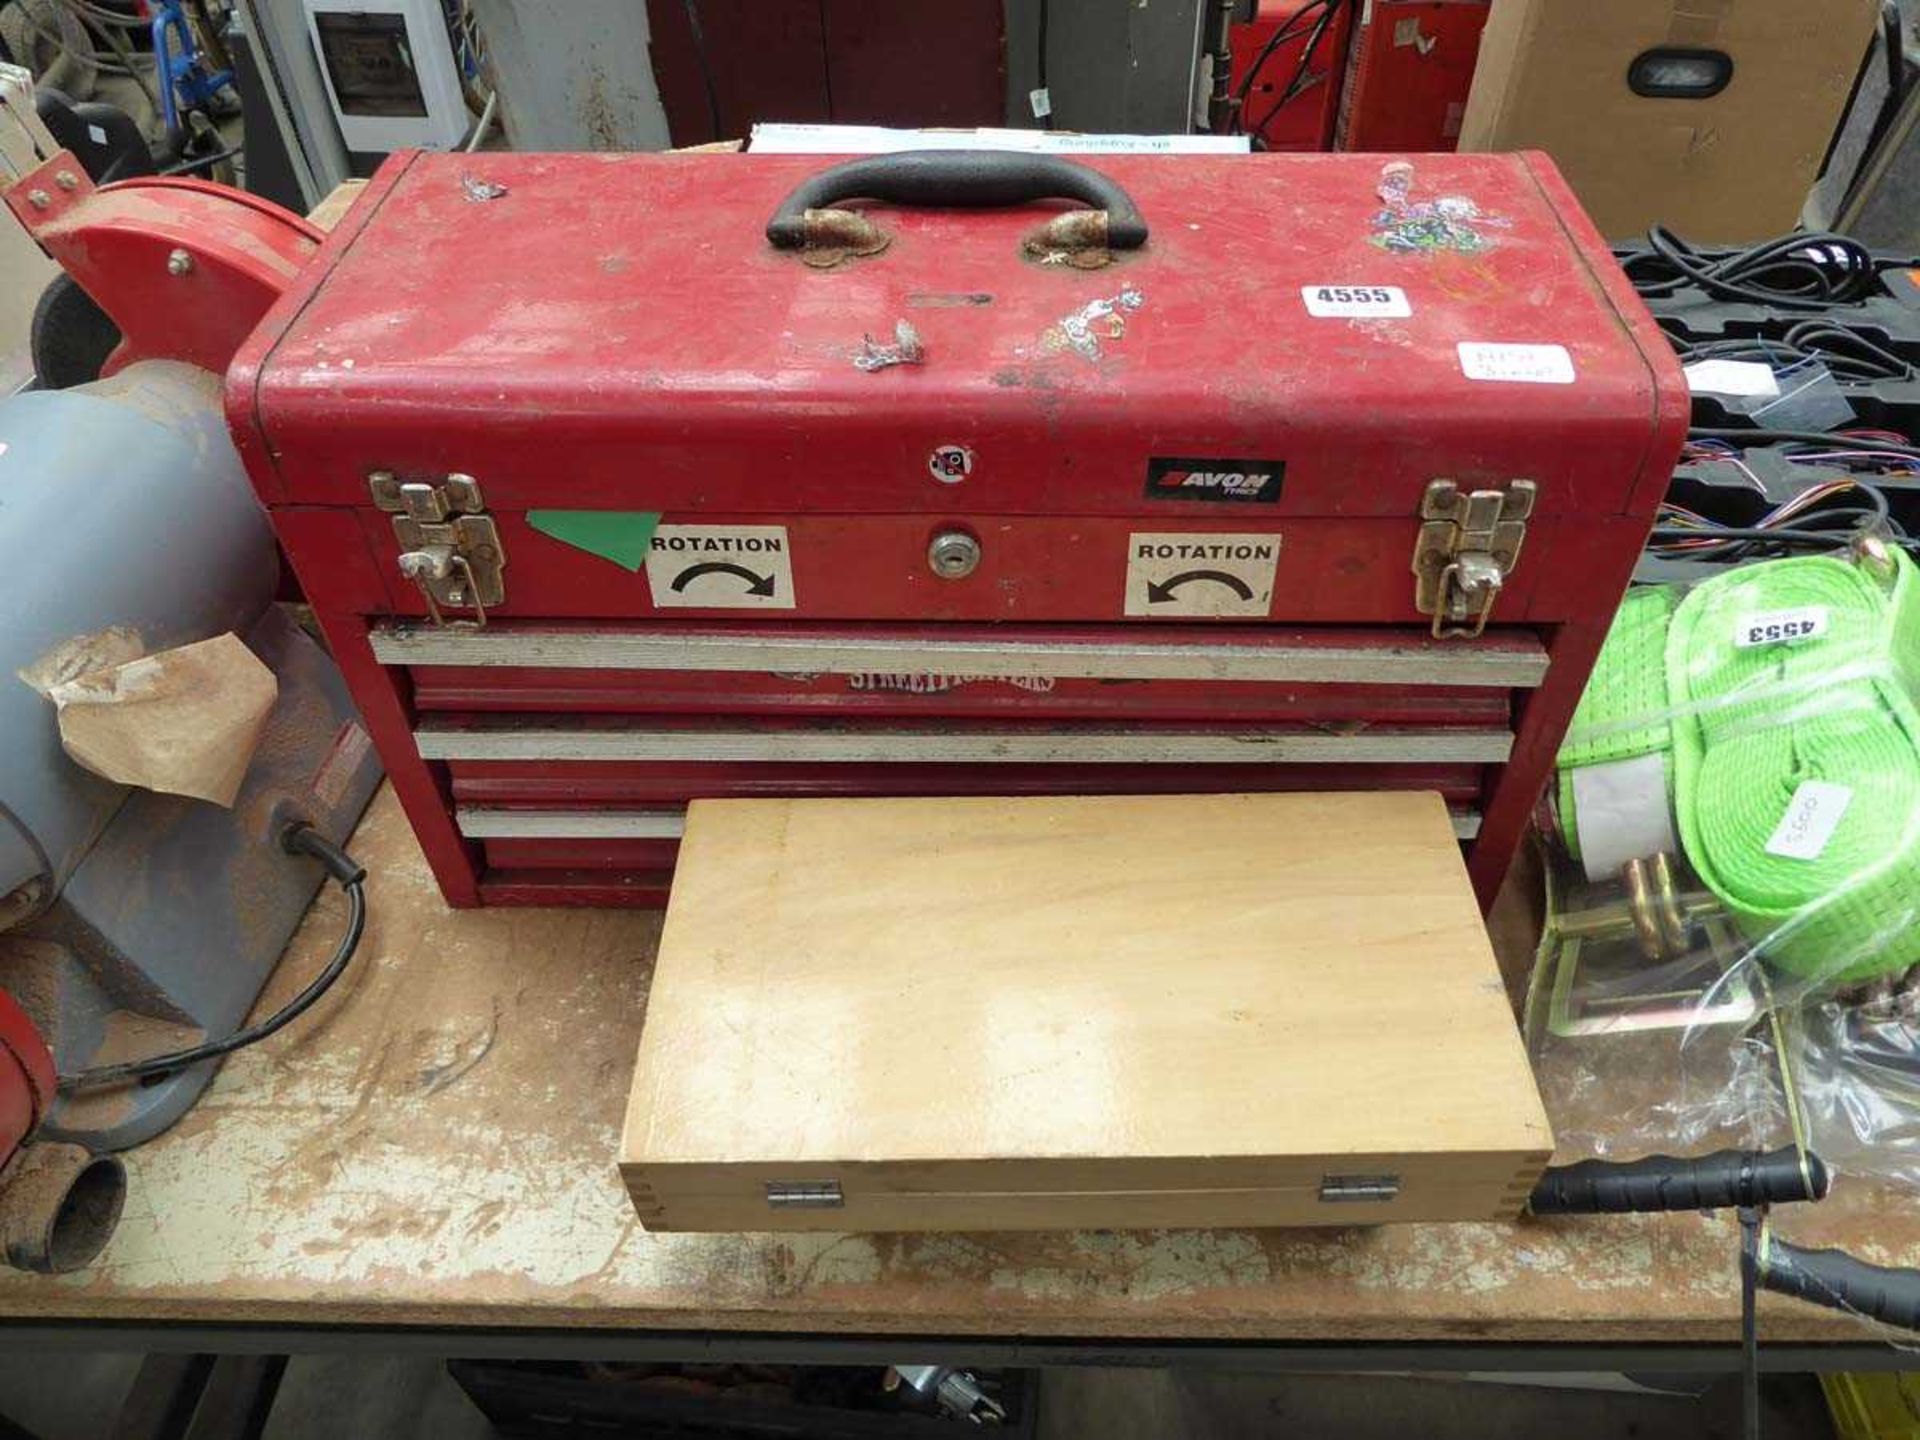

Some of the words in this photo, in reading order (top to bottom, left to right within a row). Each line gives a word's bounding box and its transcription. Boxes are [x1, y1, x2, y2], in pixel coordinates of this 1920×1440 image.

[1317, 288, 1391, 303] 4555
[1182, 472, 1271, 488] AVON
[651, 537, 781, 552] ROTATION
[1138, 544, 1272, 559] ROTATION
[1749, 620, 1815, 643] 4553
